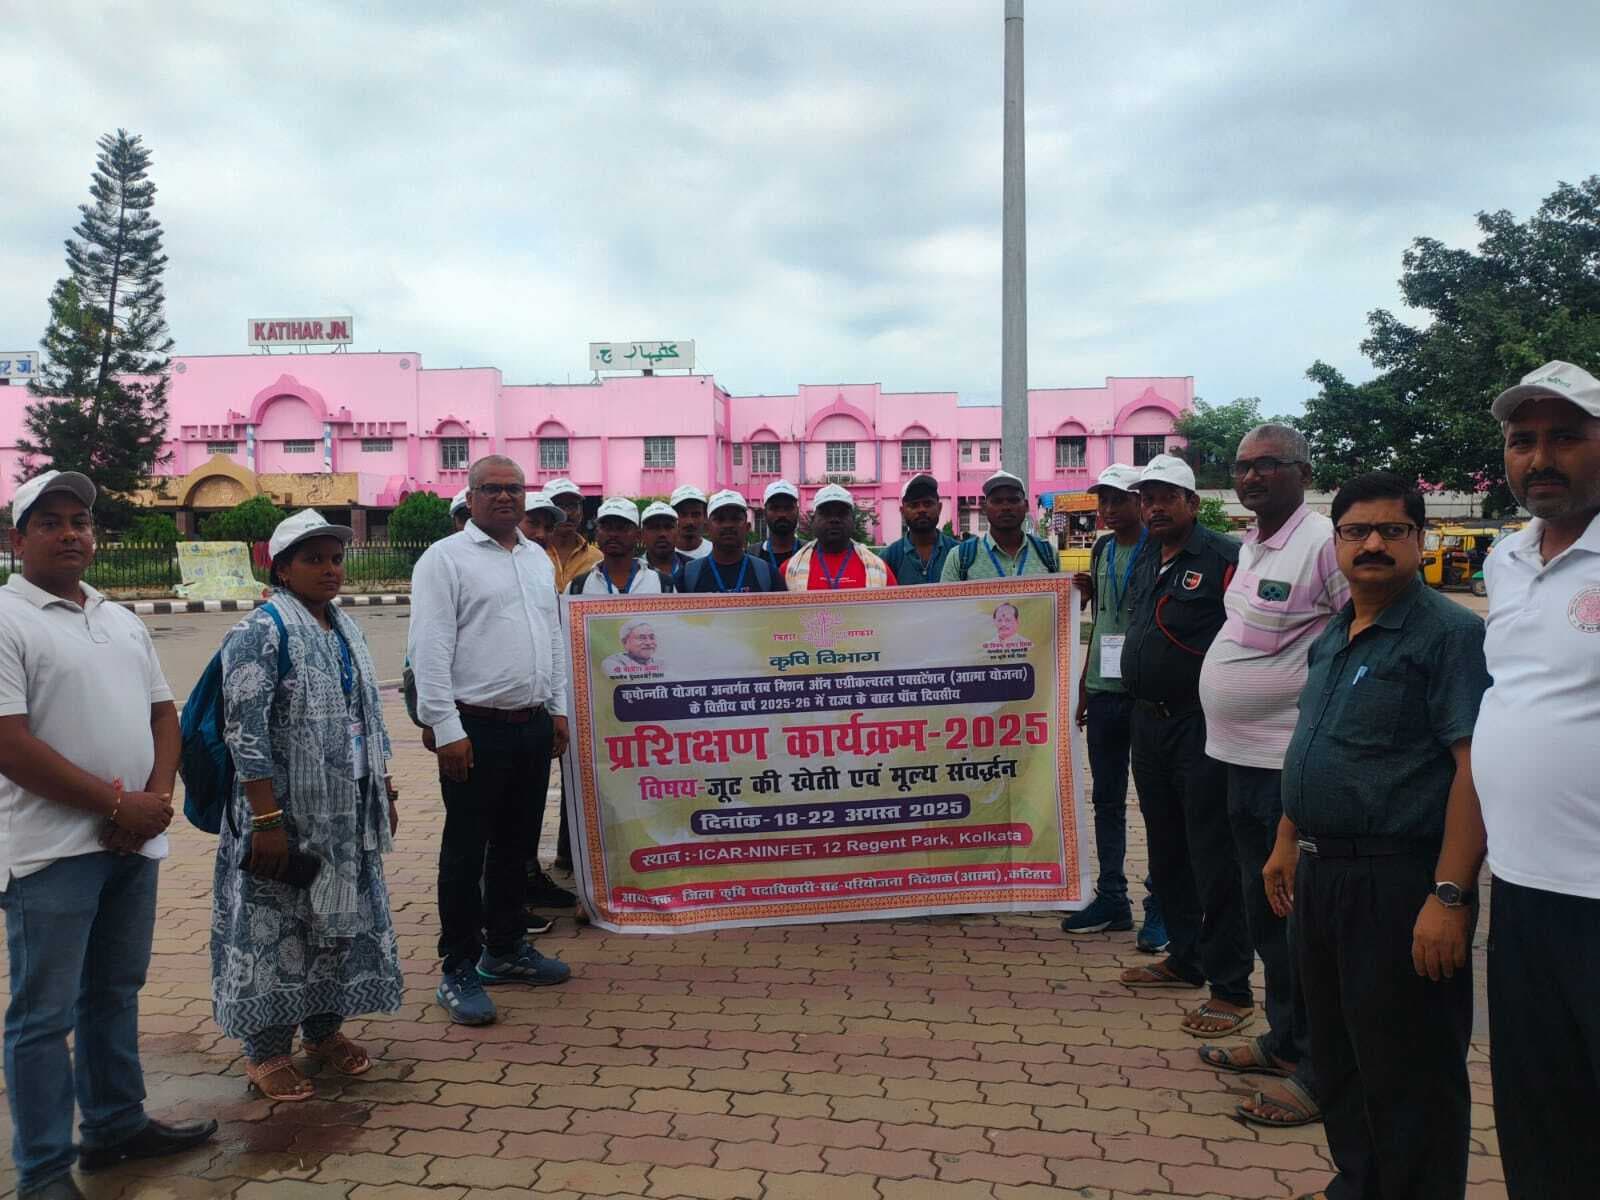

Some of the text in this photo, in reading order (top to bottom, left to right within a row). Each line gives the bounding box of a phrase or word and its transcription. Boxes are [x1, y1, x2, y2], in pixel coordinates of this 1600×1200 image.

[254, 320, 349, 340] KATIHAR JN.
[769, 649, 881, 671] कृषि विभाग
[672, 684, 707, 699] योजना
[774, 678, 805, 692] मिशन
[808, 677, 831, 690] ऑन
[989, 665, 1028, 683] योजना)
[689, 702, 701, 715] के
[760, 697, 811, 710] 2025-26
[814, 694, 826, 708] में
[828, 694, 852, 706] राज्य
[856, 692, 867, 705] के
[921, 687, 961, 701] दिवसीय
[604, 712, 1049, 772] प्रशिक्षण कार्यक्रम-2025
[750, 769, 782, 794] की
[789, 765, 840, 791] खेती
[848, 762, 883, 788] एवं
[889, 763, 938, 792] मूल्य
[844, 804, 902, 822] अगस्त
[908, 800, 963, 818] 2025
[641, 850, 681, 867] स्थान
[820, 840, 841, 854] 12
[846, 836, 907, 854] Regent
[911, 832, 953, 849] Park,
[960, 830, 1022, 845] Kolkata
